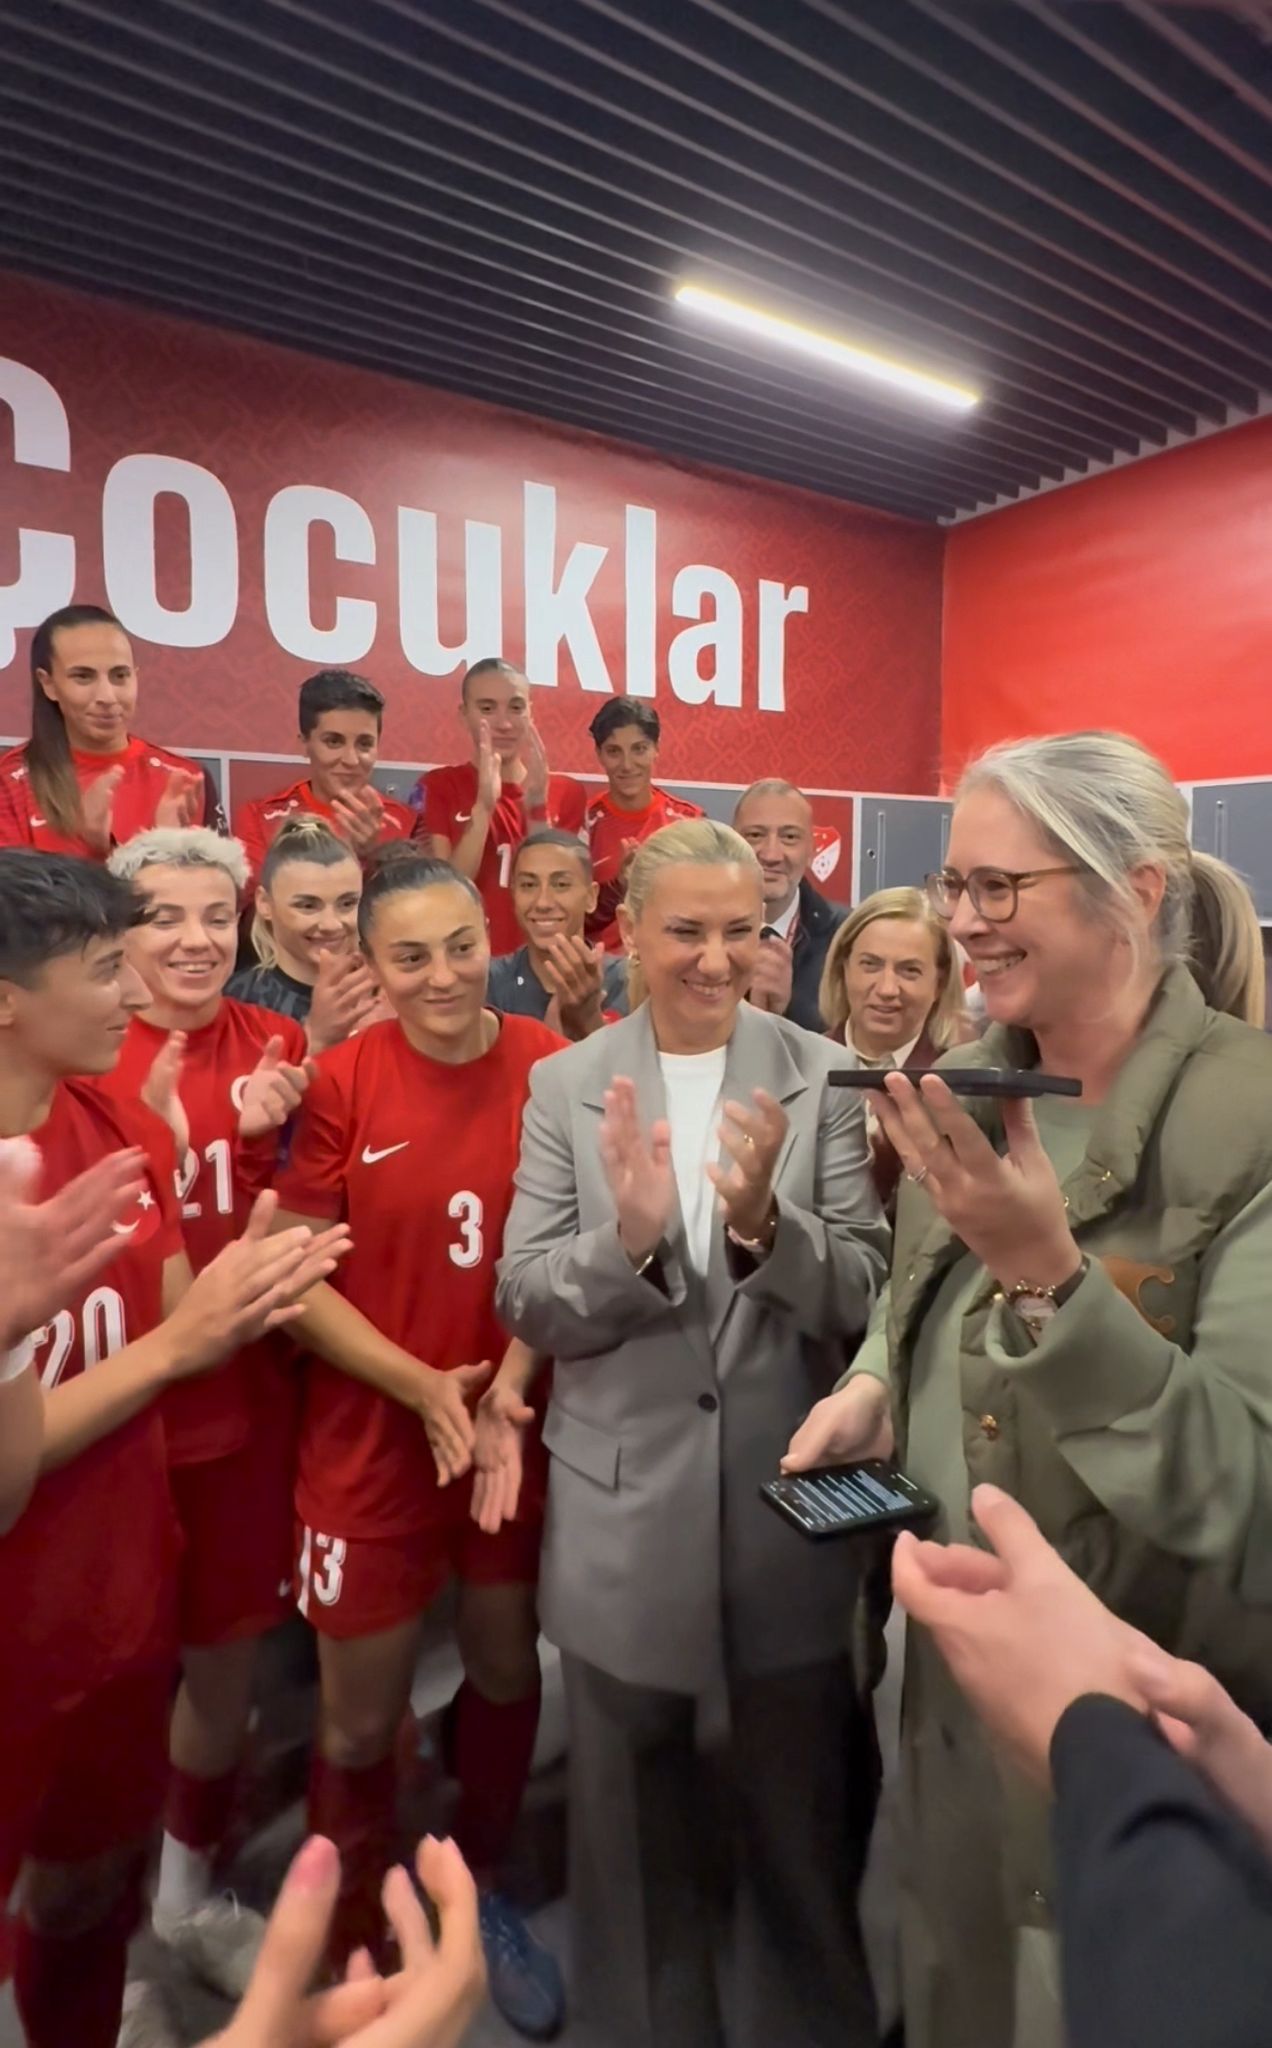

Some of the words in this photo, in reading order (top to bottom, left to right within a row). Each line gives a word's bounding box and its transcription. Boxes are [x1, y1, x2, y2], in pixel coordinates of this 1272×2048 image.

[173, 1138, 233, 1219] 21
[448, 1190, 483, 1268] 3
[30, 1286, 127, 1390] 20
